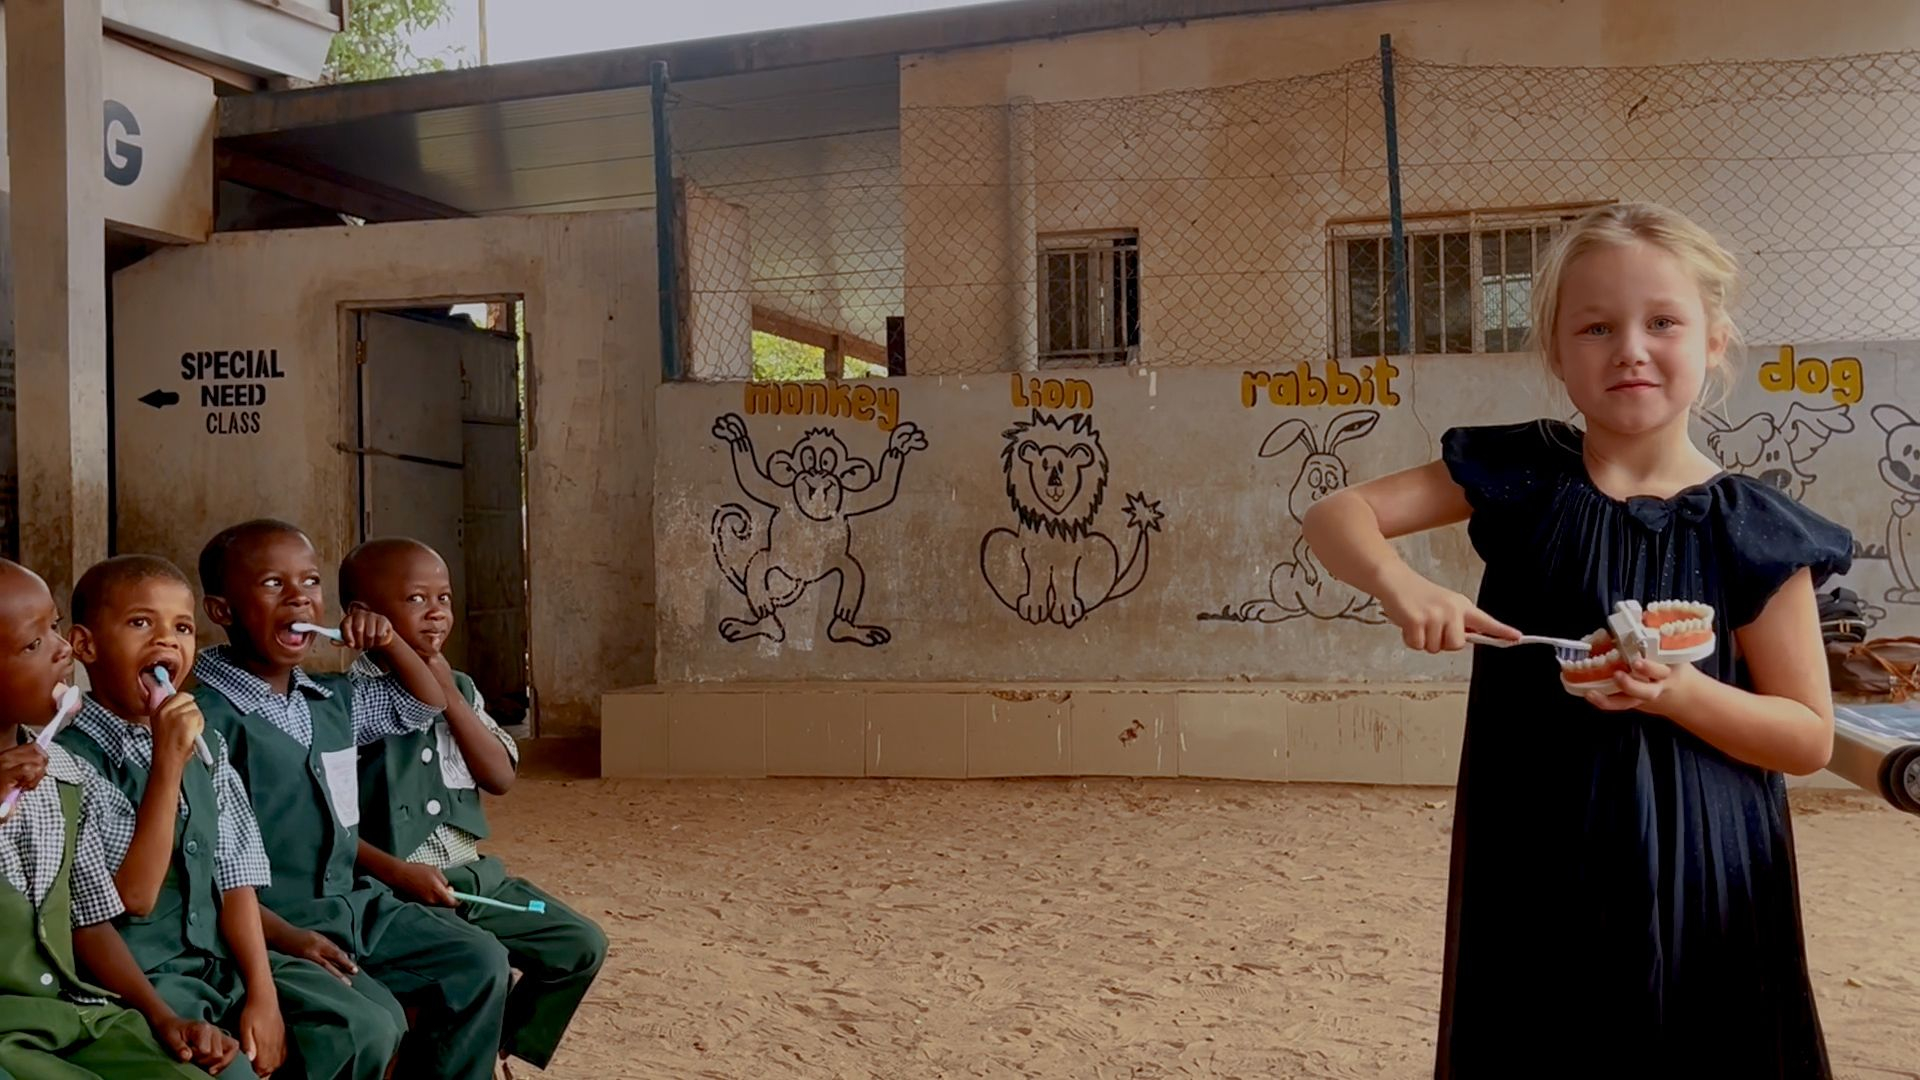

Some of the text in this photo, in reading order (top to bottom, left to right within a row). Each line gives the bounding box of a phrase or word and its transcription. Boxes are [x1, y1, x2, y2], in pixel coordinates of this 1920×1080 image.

[181, 349, 285, 380] SPECIAL
[1241, 355, 1401, 408] rabbit
[1758, 344, 1864, 404] dog
[201, 384, 266, 407] NEED
[744, 377, 900, 432] monkey
[206, 411, 261, 434] CLASS
